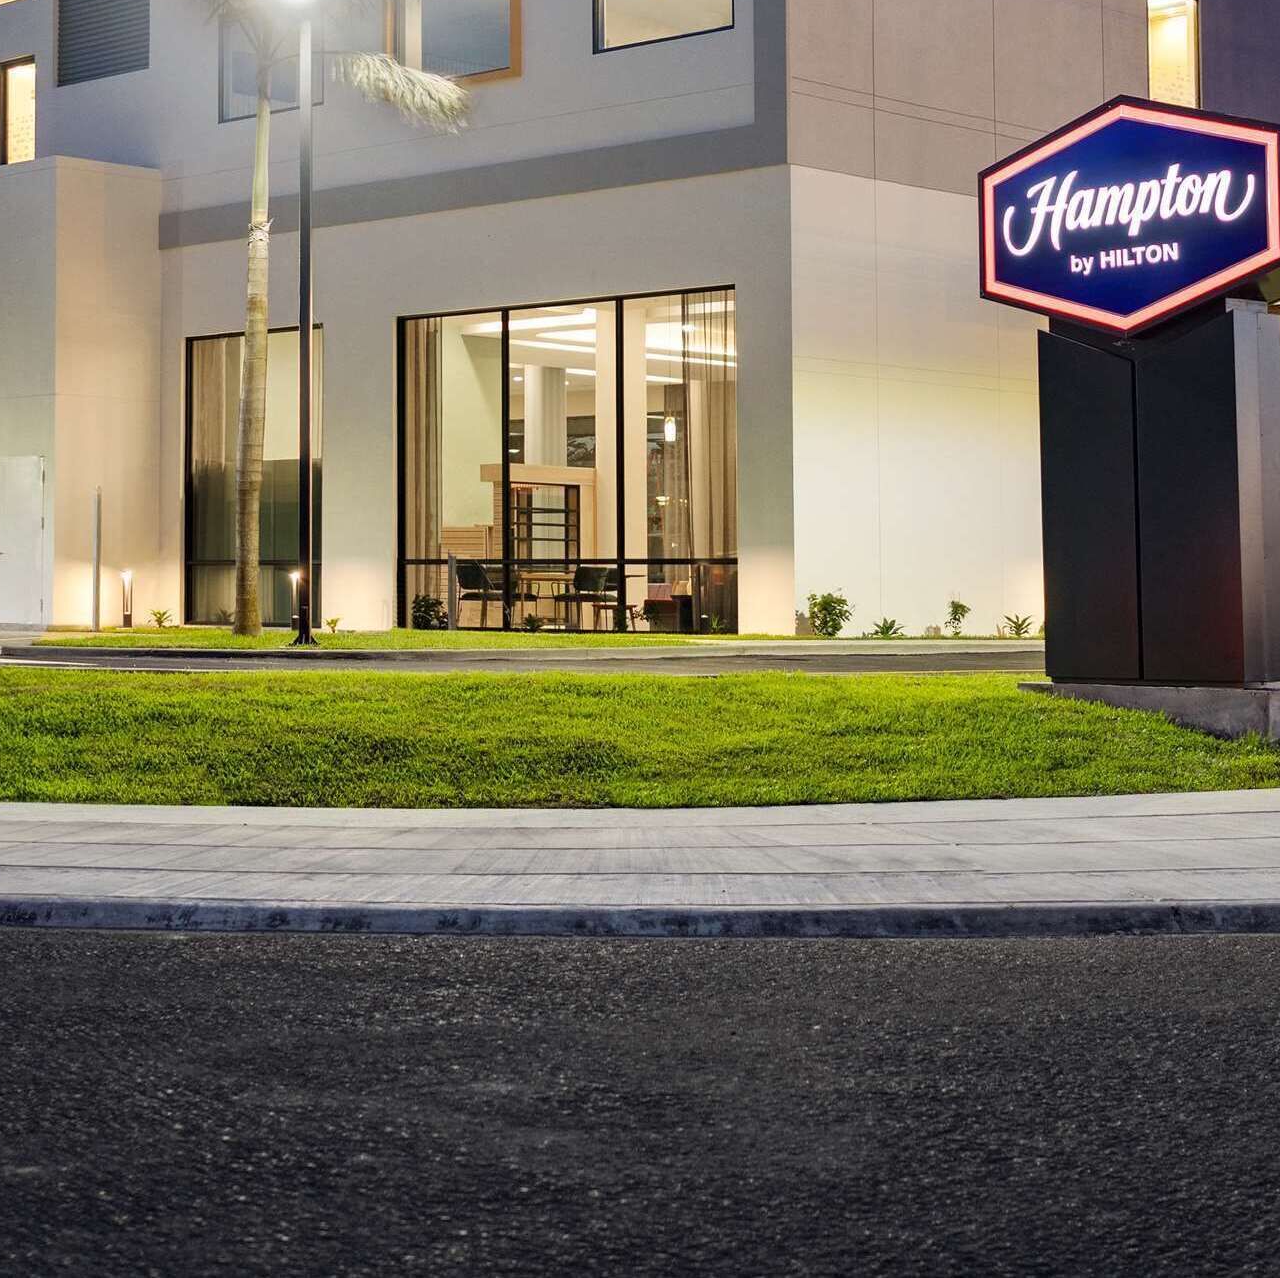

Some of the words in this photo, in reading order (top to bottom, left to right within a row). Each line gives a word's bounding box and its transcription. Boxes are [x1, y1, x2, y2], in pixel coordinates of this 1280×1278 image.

[1003, 163, 1255, 257] Hampton
[1070, 254, 1094, 275] by
[1099, 242, 1179, 269] HILTON
